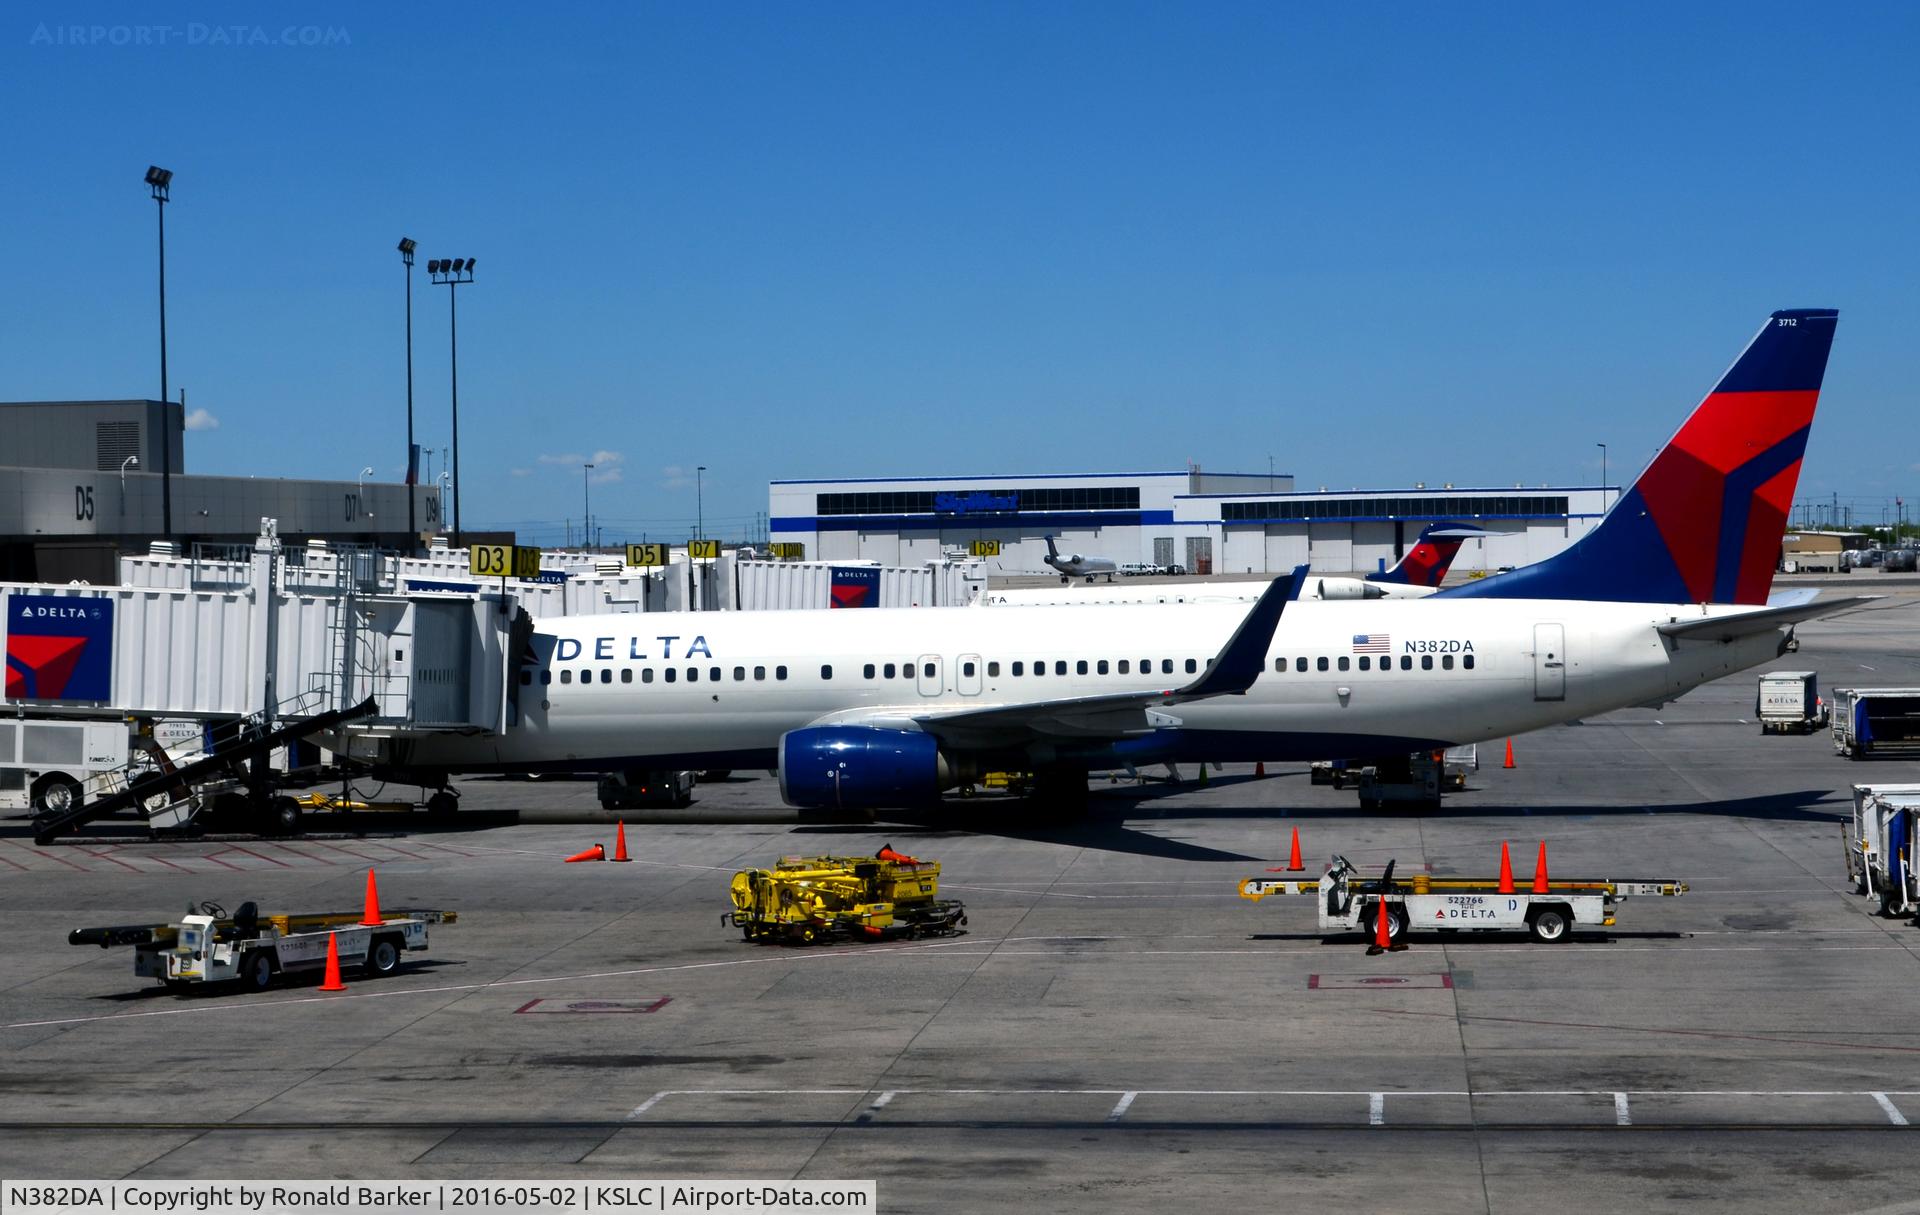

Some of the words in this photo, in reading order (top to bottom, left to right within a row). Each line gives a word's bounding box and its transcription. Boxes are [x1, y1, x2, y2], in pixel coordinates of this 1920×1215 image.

[1778, 318, 1797, 327] 3712
[75, 485, 95, 521] D5
[344, 493, 357, 523] D7
[425, 495, 438, 523] D9
[632, 545, 656, 565] D5
[693, 541, 711, 556] D7
[979, 541, 995, 554] D9
[477, 546, 505, 573] D3
[520, 549, 537, 575] D3
[37, 607, 87, 618] DELTA
[556, 636, 713, 661] DELTA
[1405, 640, 1475, 653] N382DA
[1448, 896, 1484, 904] 522766
[1450, 909, 1496, 918] DELTA
